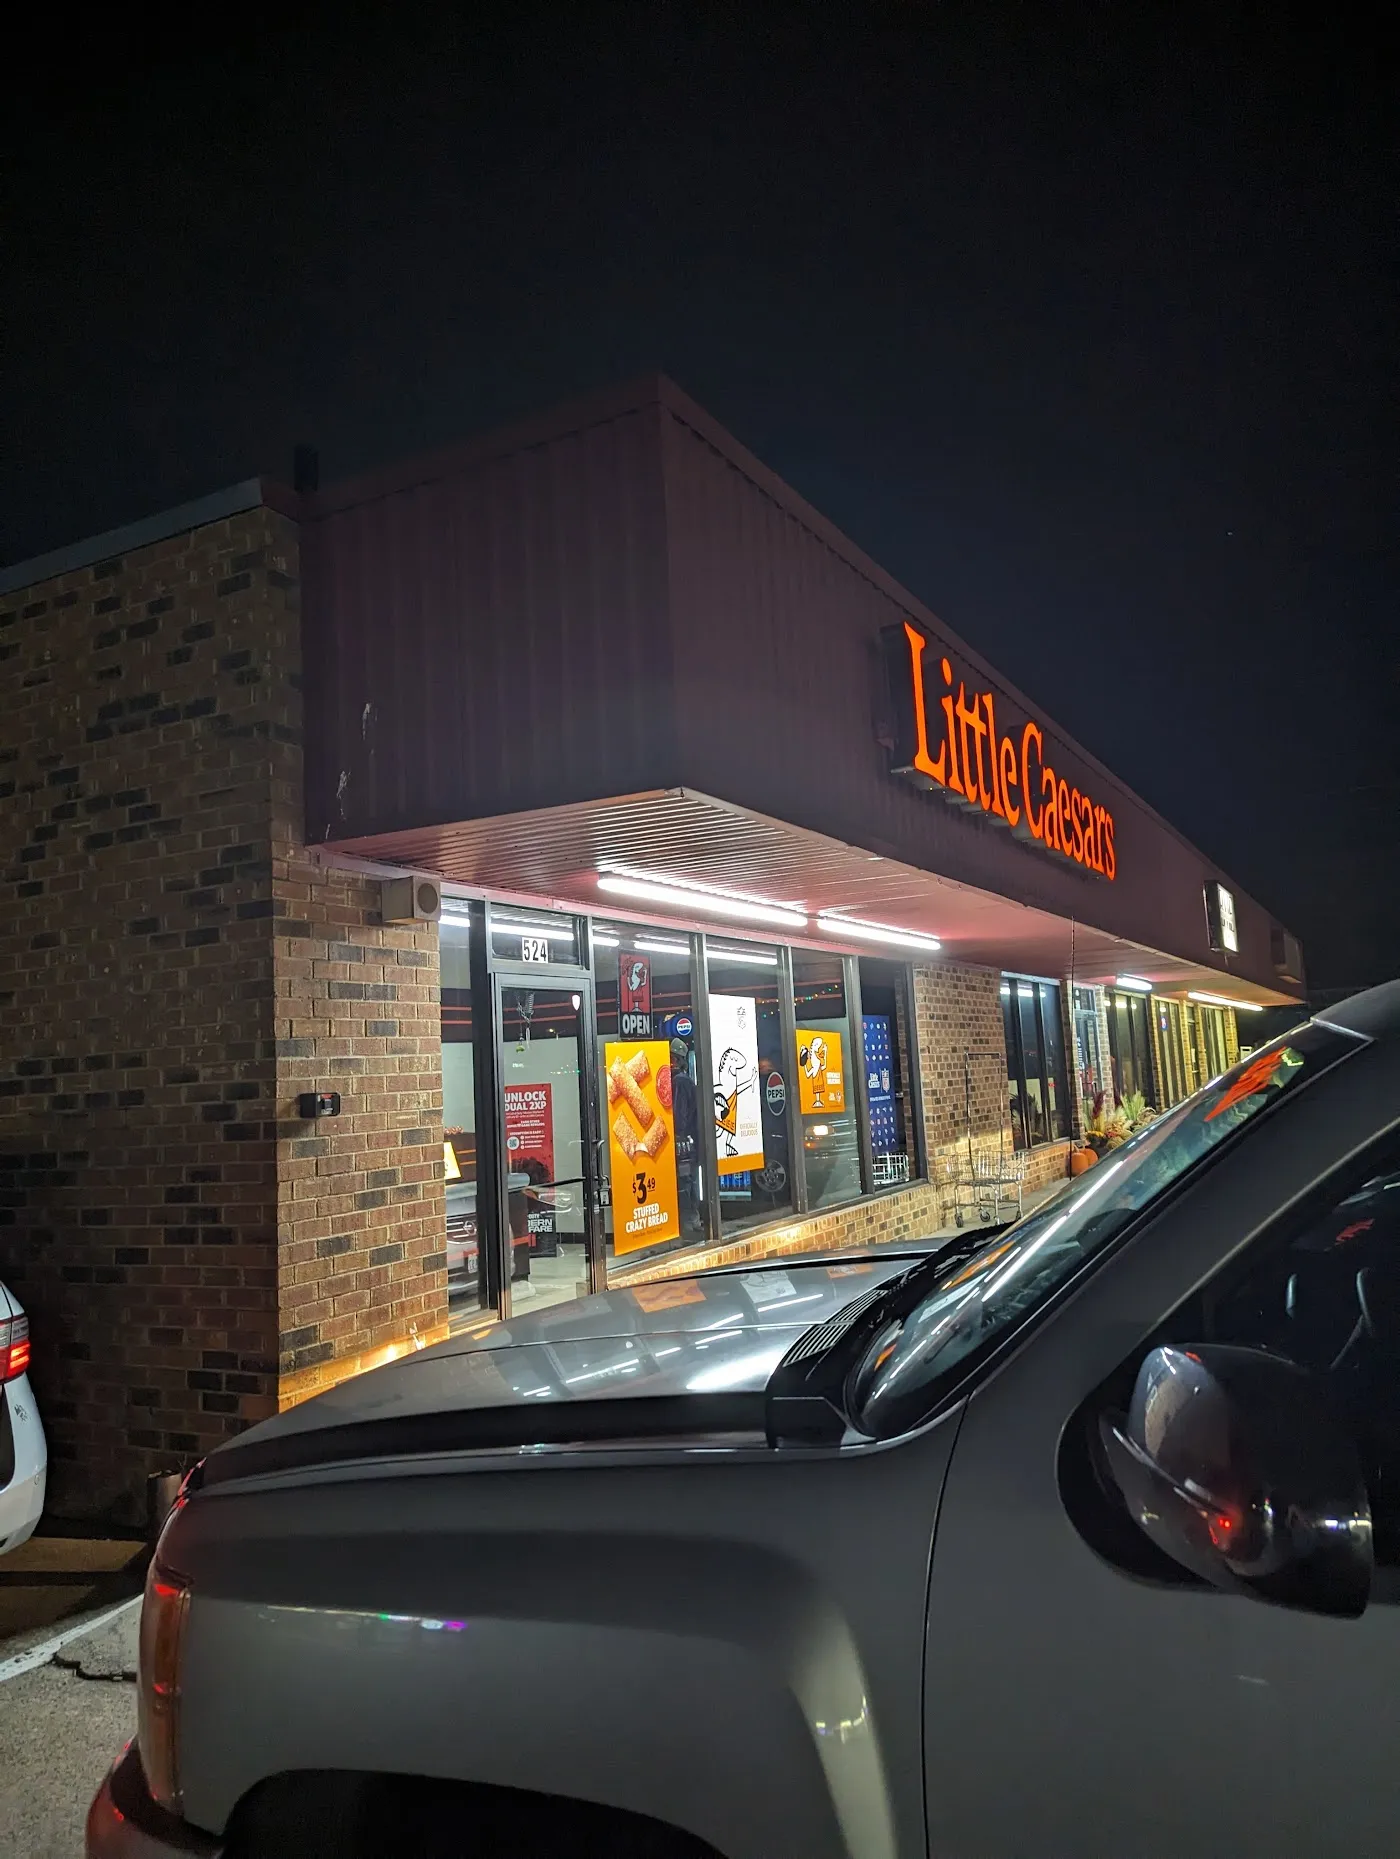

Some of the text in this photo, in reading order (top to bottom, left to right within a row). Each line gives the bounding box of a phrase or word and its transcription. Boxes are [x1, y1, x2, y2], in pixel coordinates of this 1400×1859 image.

[904, 621, 1116, 881] Little Caesars
[523, 939, 547, 962] 524
[622, 1014, 650, 1034] OPEN
[504, 1091, 547, 1103] UNLOCK
[767, 1089, 785, 1099] PEPSI
[504, 1101, 547, 1112] DUAL 2XP
[633, 1203, 660, 1219] STUFFED
[625, 1212, 668, 1233] CRAZY BREAD
